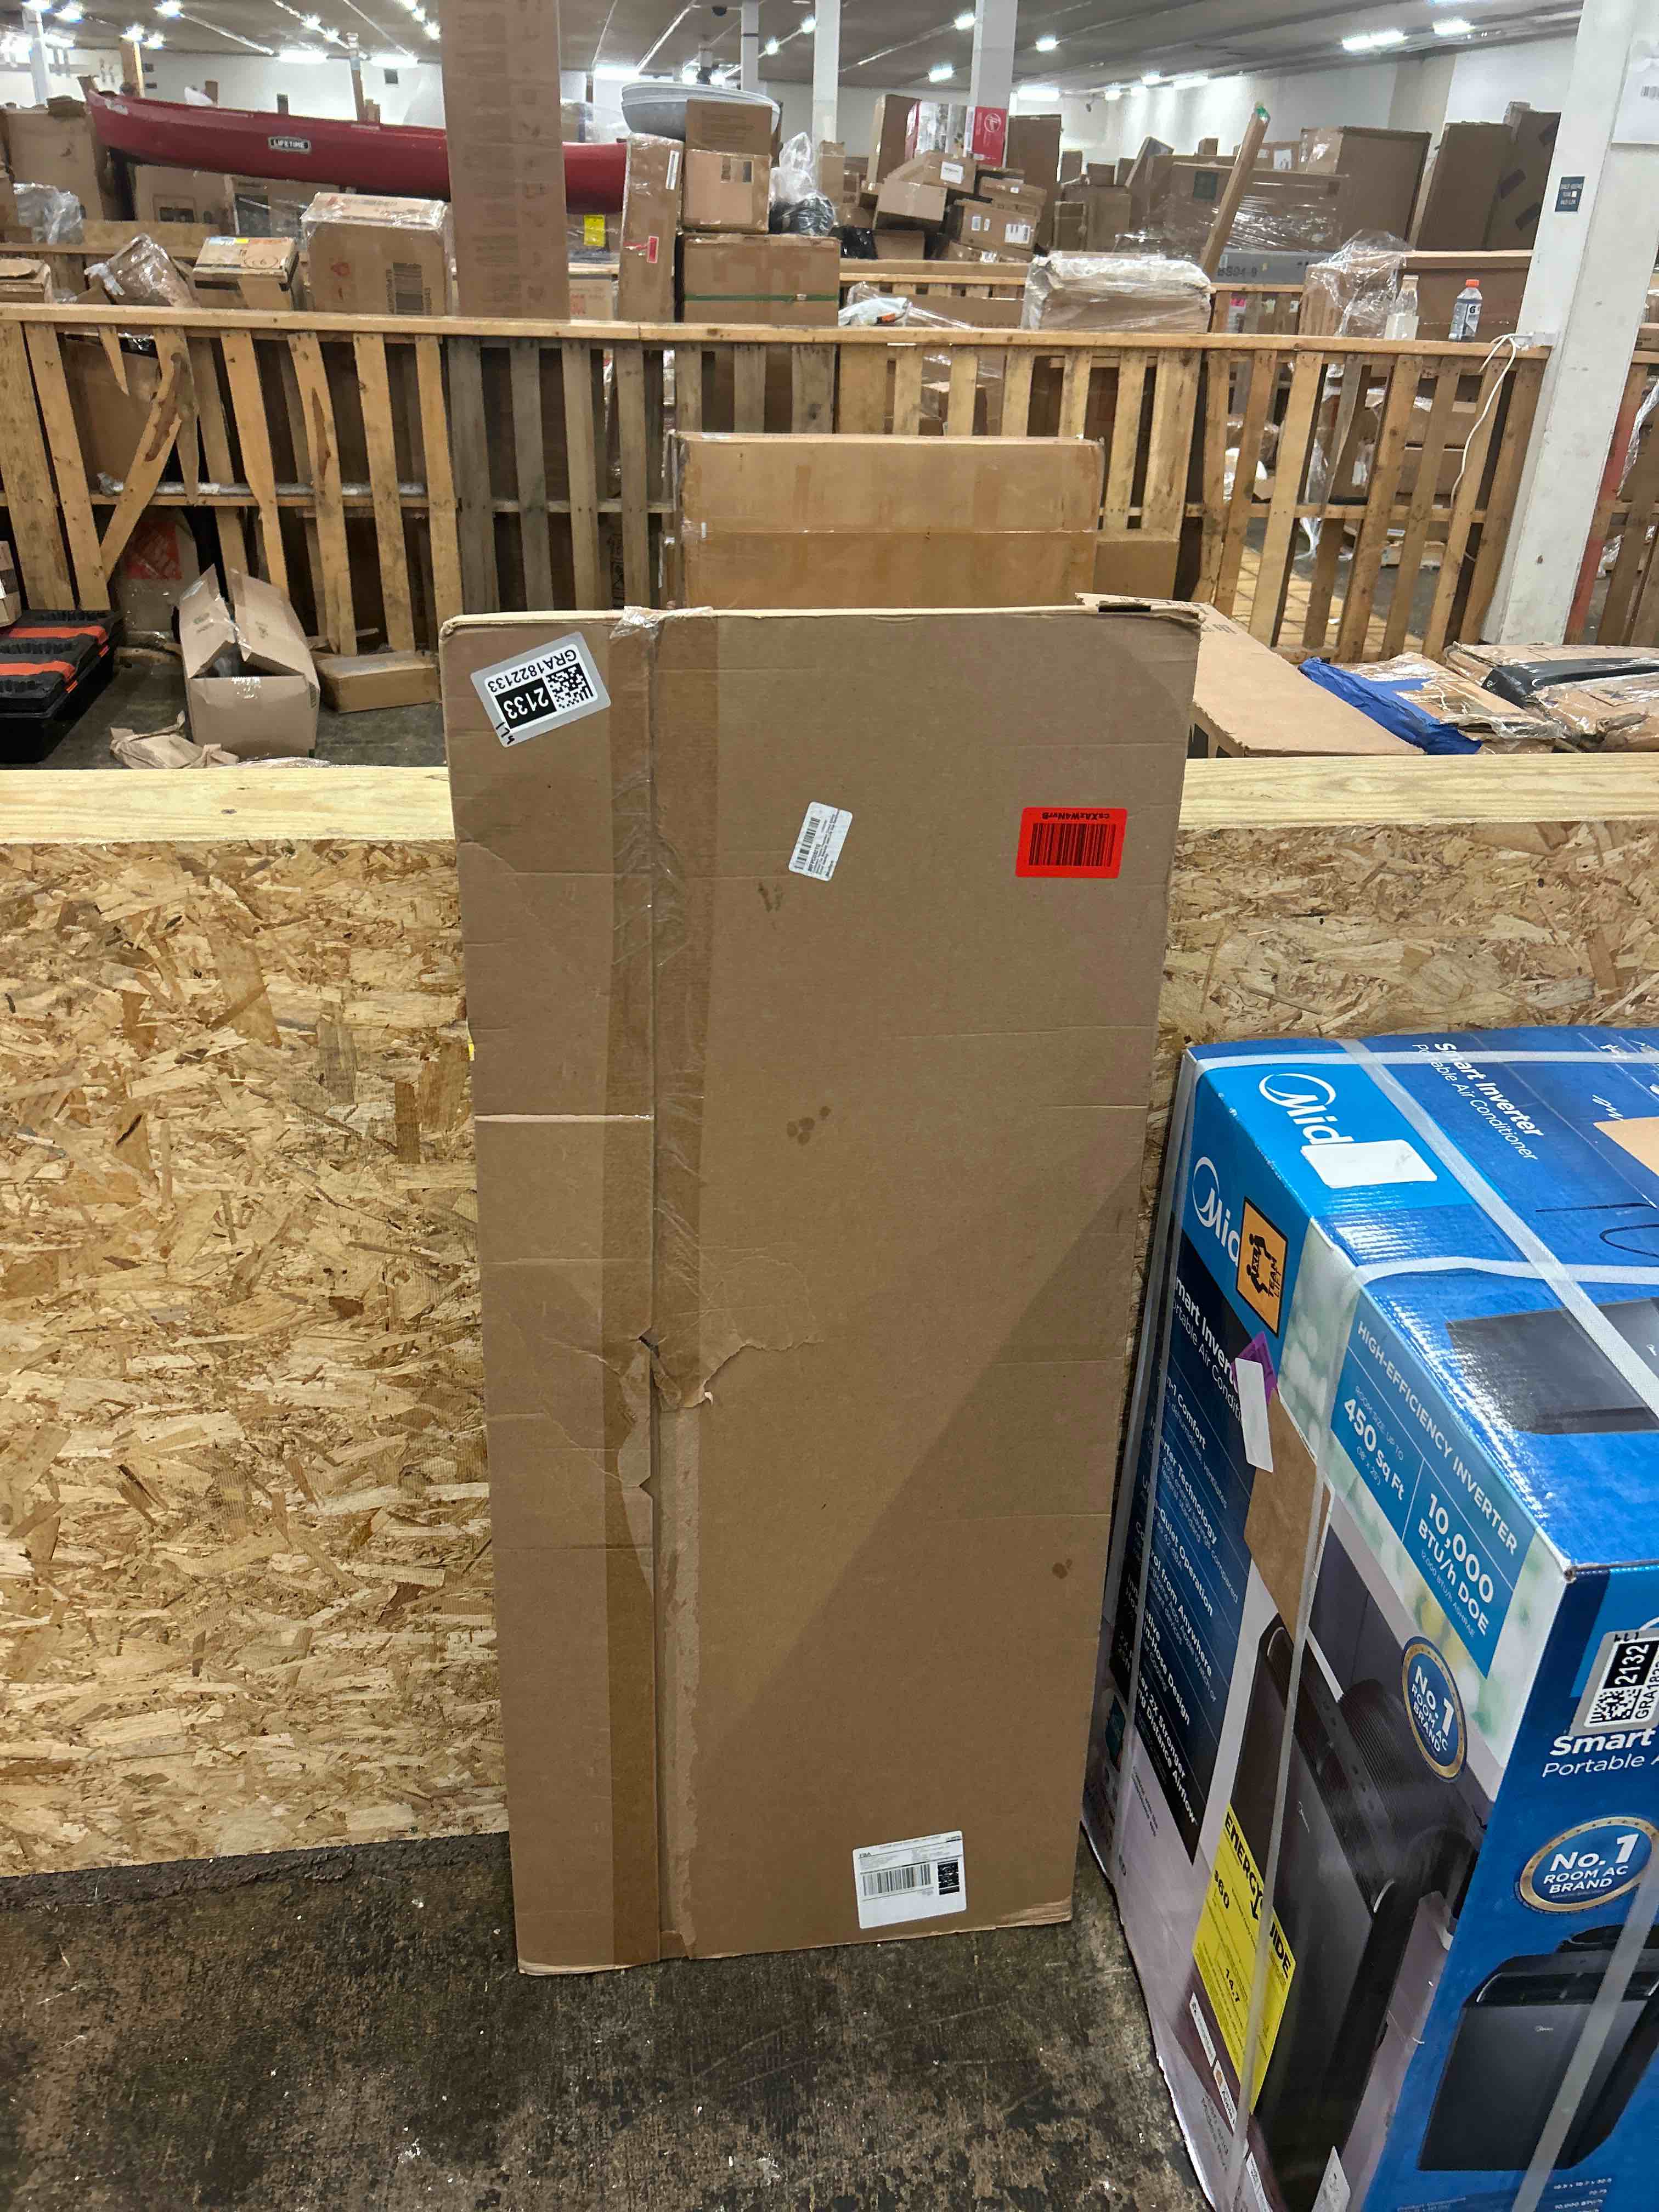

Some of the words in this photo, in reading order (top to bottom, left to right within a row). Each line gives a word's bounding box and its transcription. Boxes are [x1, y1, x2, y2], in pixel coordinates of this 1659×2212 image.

[488, 649, 577, 692] GRA1822133
[503, 687, 549, 719] 2133
[1259, 1073, 1355, 1145] Mid
[1412, 1043, 1458, 1082] Poable
[1452, 1083, 1475, 1098] Air
[1470, 1099, 1538, 1160] Conditioner
[1434, 1042, 1486, 1080] Sart
[1475, 1082, 1544, 1137] Inverter
[1267, 1255, 1277, 1298] TEAM
[1273, 1268, 1282, 1298] LIFT
[1173, 1300, 1198, 1345] ortable
[1198, 1343, 1210, 1367] Air
[1212, 1364, 1242, 1422] Conditi
[1176, 1277, 1200, 1326] mart
[1202, 1317, 1238, 1393] Invert
[1177, 1393, 1206, 1450] Comfort
[1344, 1398, 1377, 1452] 450
[1375, 1449, 1391, 1482] Sq
[1391, 1472, 1404, 1500] Ft
[1357, 1321, 1453, 1459] HIGH-EFFICIENCY
[1452, 1456, 1517, 1556] INVERTER
[1178, 1463, 1217, 1544] Technology
[1179, 1545, 1213, 1617] Operation
[1418, 1518, 1457, 1586] BTU/h
[1457, 1581, 1489, 1636] DOE
[1428, 1493, 1494, 1604] 10,000
[1161, 1568, 1177, 1605] from
[1178, 1604, 1212, 1677] Anywhere
[1167, 1672, 1190, 1725] Design
[1614, 1644, 1650, 1685] 2132
[1412, 1684, 1435, 1730] ROOM
[1436, 1730, 1448, 1752] AC
[1413, 1704, 1440, 1752] BRAND
[1415, 1666, 1440, 1720] No.
[1442, 1697, 1454, 1737] 1
[1146, 1705, 1172, 1768] Distance
[1149, 1694, 1158, 1717] 2X
[1158, 1715, 1186, 1778] Stronger
[1542, 1753, 1645, 1778] Portable
[1550, 1729, 1656, 1756] Smart
[1543, 1869, 1598, 1884] ROOM
[1602, 1865, 1628, 1876] AC
[1549, 1852, 1606, 1872] No.
[1615, 1833, 1639, 1864] 1
[1549, 1878, 1612, 1894] BRAND
